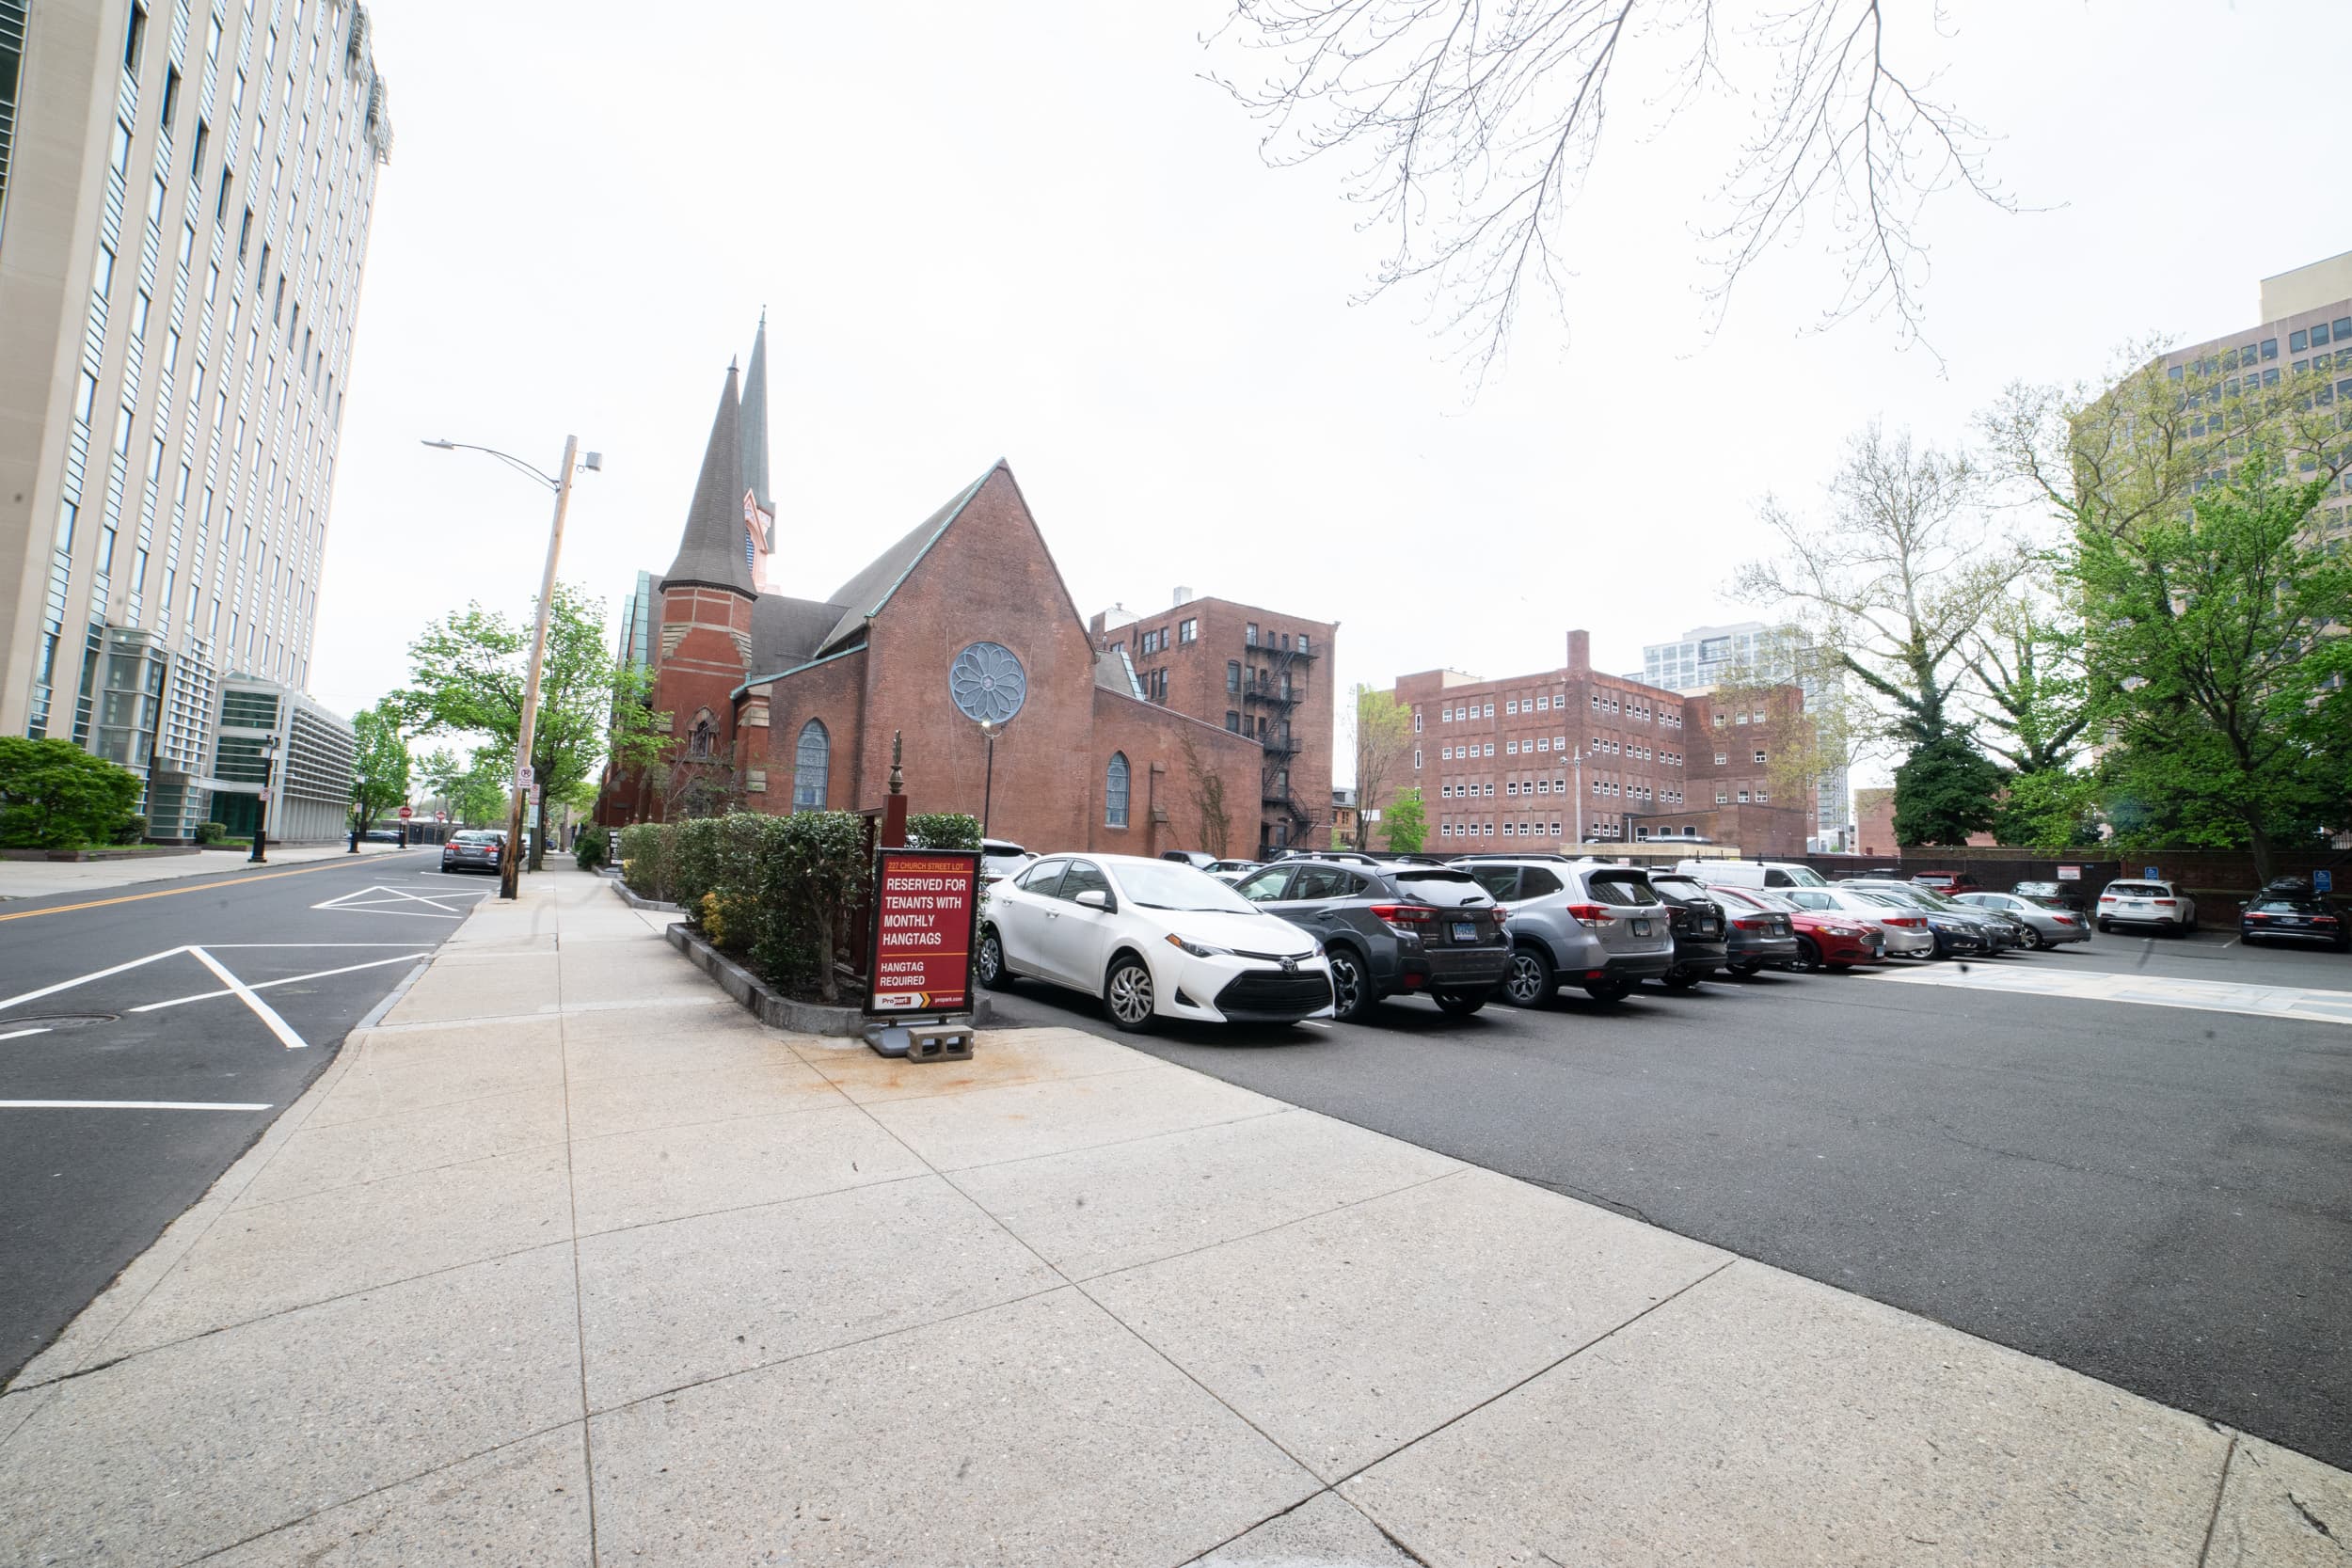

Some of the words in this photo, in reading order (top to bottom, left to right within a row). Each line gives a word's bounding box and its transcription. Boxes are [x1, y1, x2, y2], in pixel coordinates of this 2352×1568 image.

[927, 863, 951, 871] STREET
[951, 863, 964, 871] LOT
[886, 878, 943, 892] RESERVED
[945, 879, 966, 892] FOR
[885, 896, 934, 910] TENANTS
[936, 896, 962, 910] WITH
[883, 914, 935, 927] MONTHLY
[882, 932, 942, 946] HANGTAGS
[881, 961, 924, 973] HANGTAG
[880, 975, 926, 987] REQUIRED
